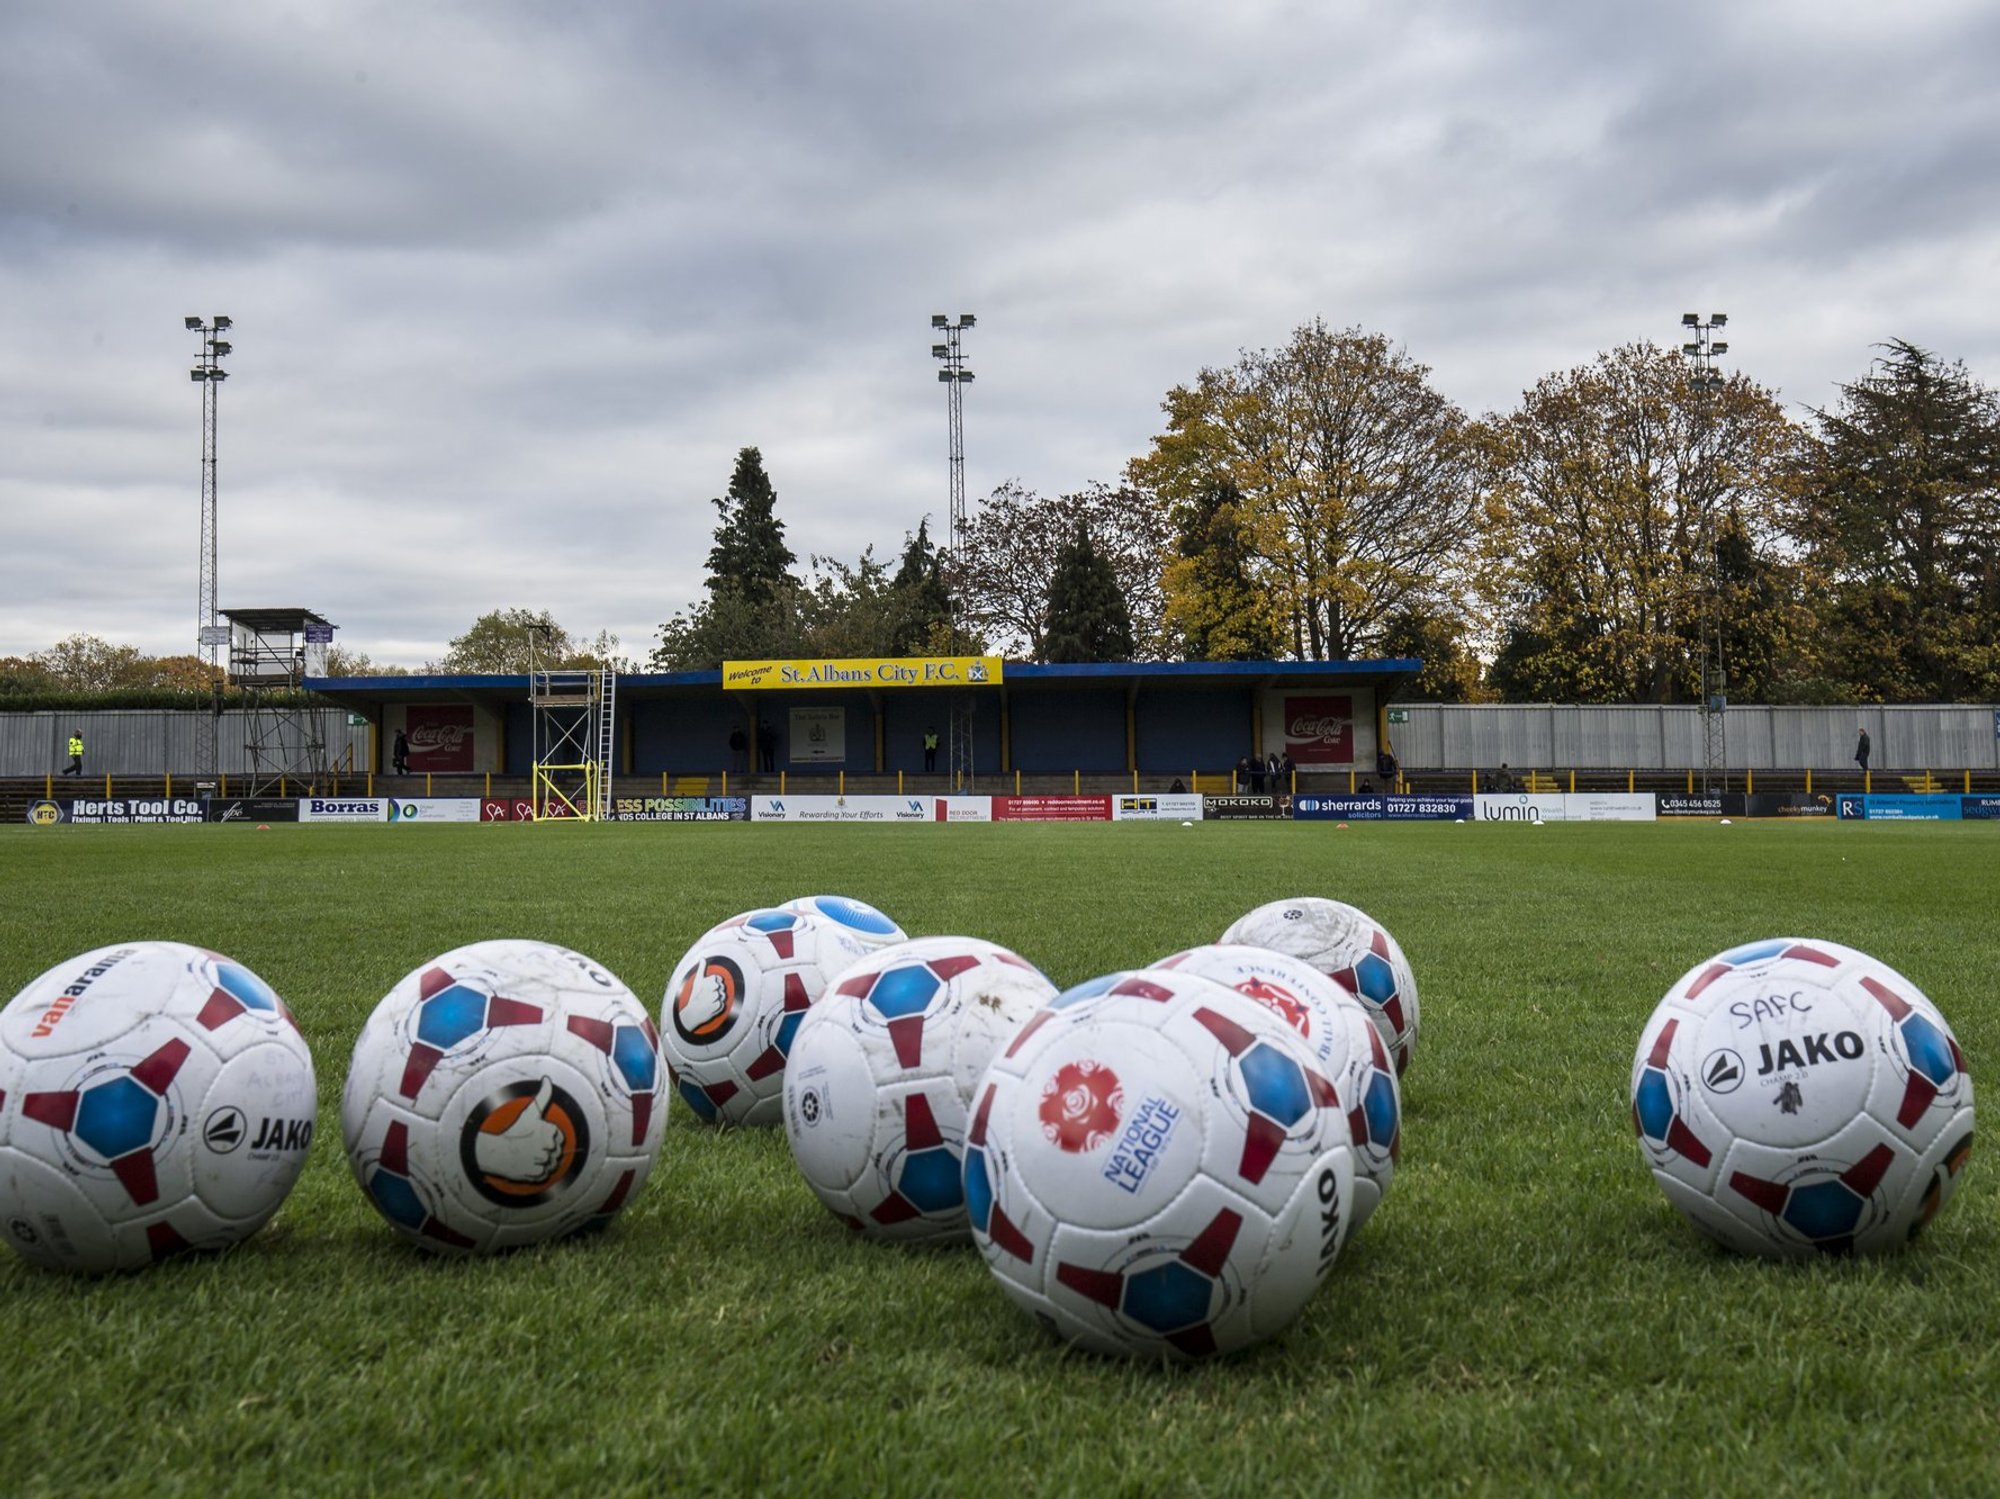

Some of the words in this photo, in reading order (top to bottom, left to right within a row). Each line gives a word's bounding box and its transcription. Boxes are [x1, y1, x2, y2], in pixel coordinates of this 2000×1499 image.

[728, 665, 773, 682] Welcome
[877, 664, 918, 684] City
[924, 663, 959, 681] F.C.
[751, 676, 761, 685] to
[72, 800, 125, 815] Herts
[129, 800, 169, 815] Tool
[174, 800, 203, 815] Co.
[310, 800, 379, 813] Borras
[1205, 798, 1272, 807] MOKOKO
[1321, 799, 1382, 811] sherrards
[1387, 804, 1415, 813] 01727
[1419, 804, 1456, 813] 832830
[1483, 796, 1539, 821] lumin
[1670, 799, 1688, 808] 0345
[1688, 799, 1702, 808] 456
[1703, 799, 1721, 808] 0525
[635, 812, 672, 821] COLLEGE
[674, 812, 682, 820] IN
[684, 812, 695, 820] ST
[695, 812, 729, 821] ALBANS
[758, 811, 786, 819] Visionary
[799, 811, 840, 819] Rewarding
[841, 811, 857, 819] Your
[860, 811, 884, 819] Efforts
[896, 811, 924, 819] Visionary
[1348, 811, 1382, 819] solicitors
[31, 948, 138, 1038] vanarama
[1730, 991, 1812, 1029] SAFC
[1758, 1031, 1864, 1076] JAKO
[250, 1117, 312, 1151] JAKO
[1104, 1097, 1162, 1183] NATIONAL
[1118, 1101, 1180, 1194] LEAGUE
